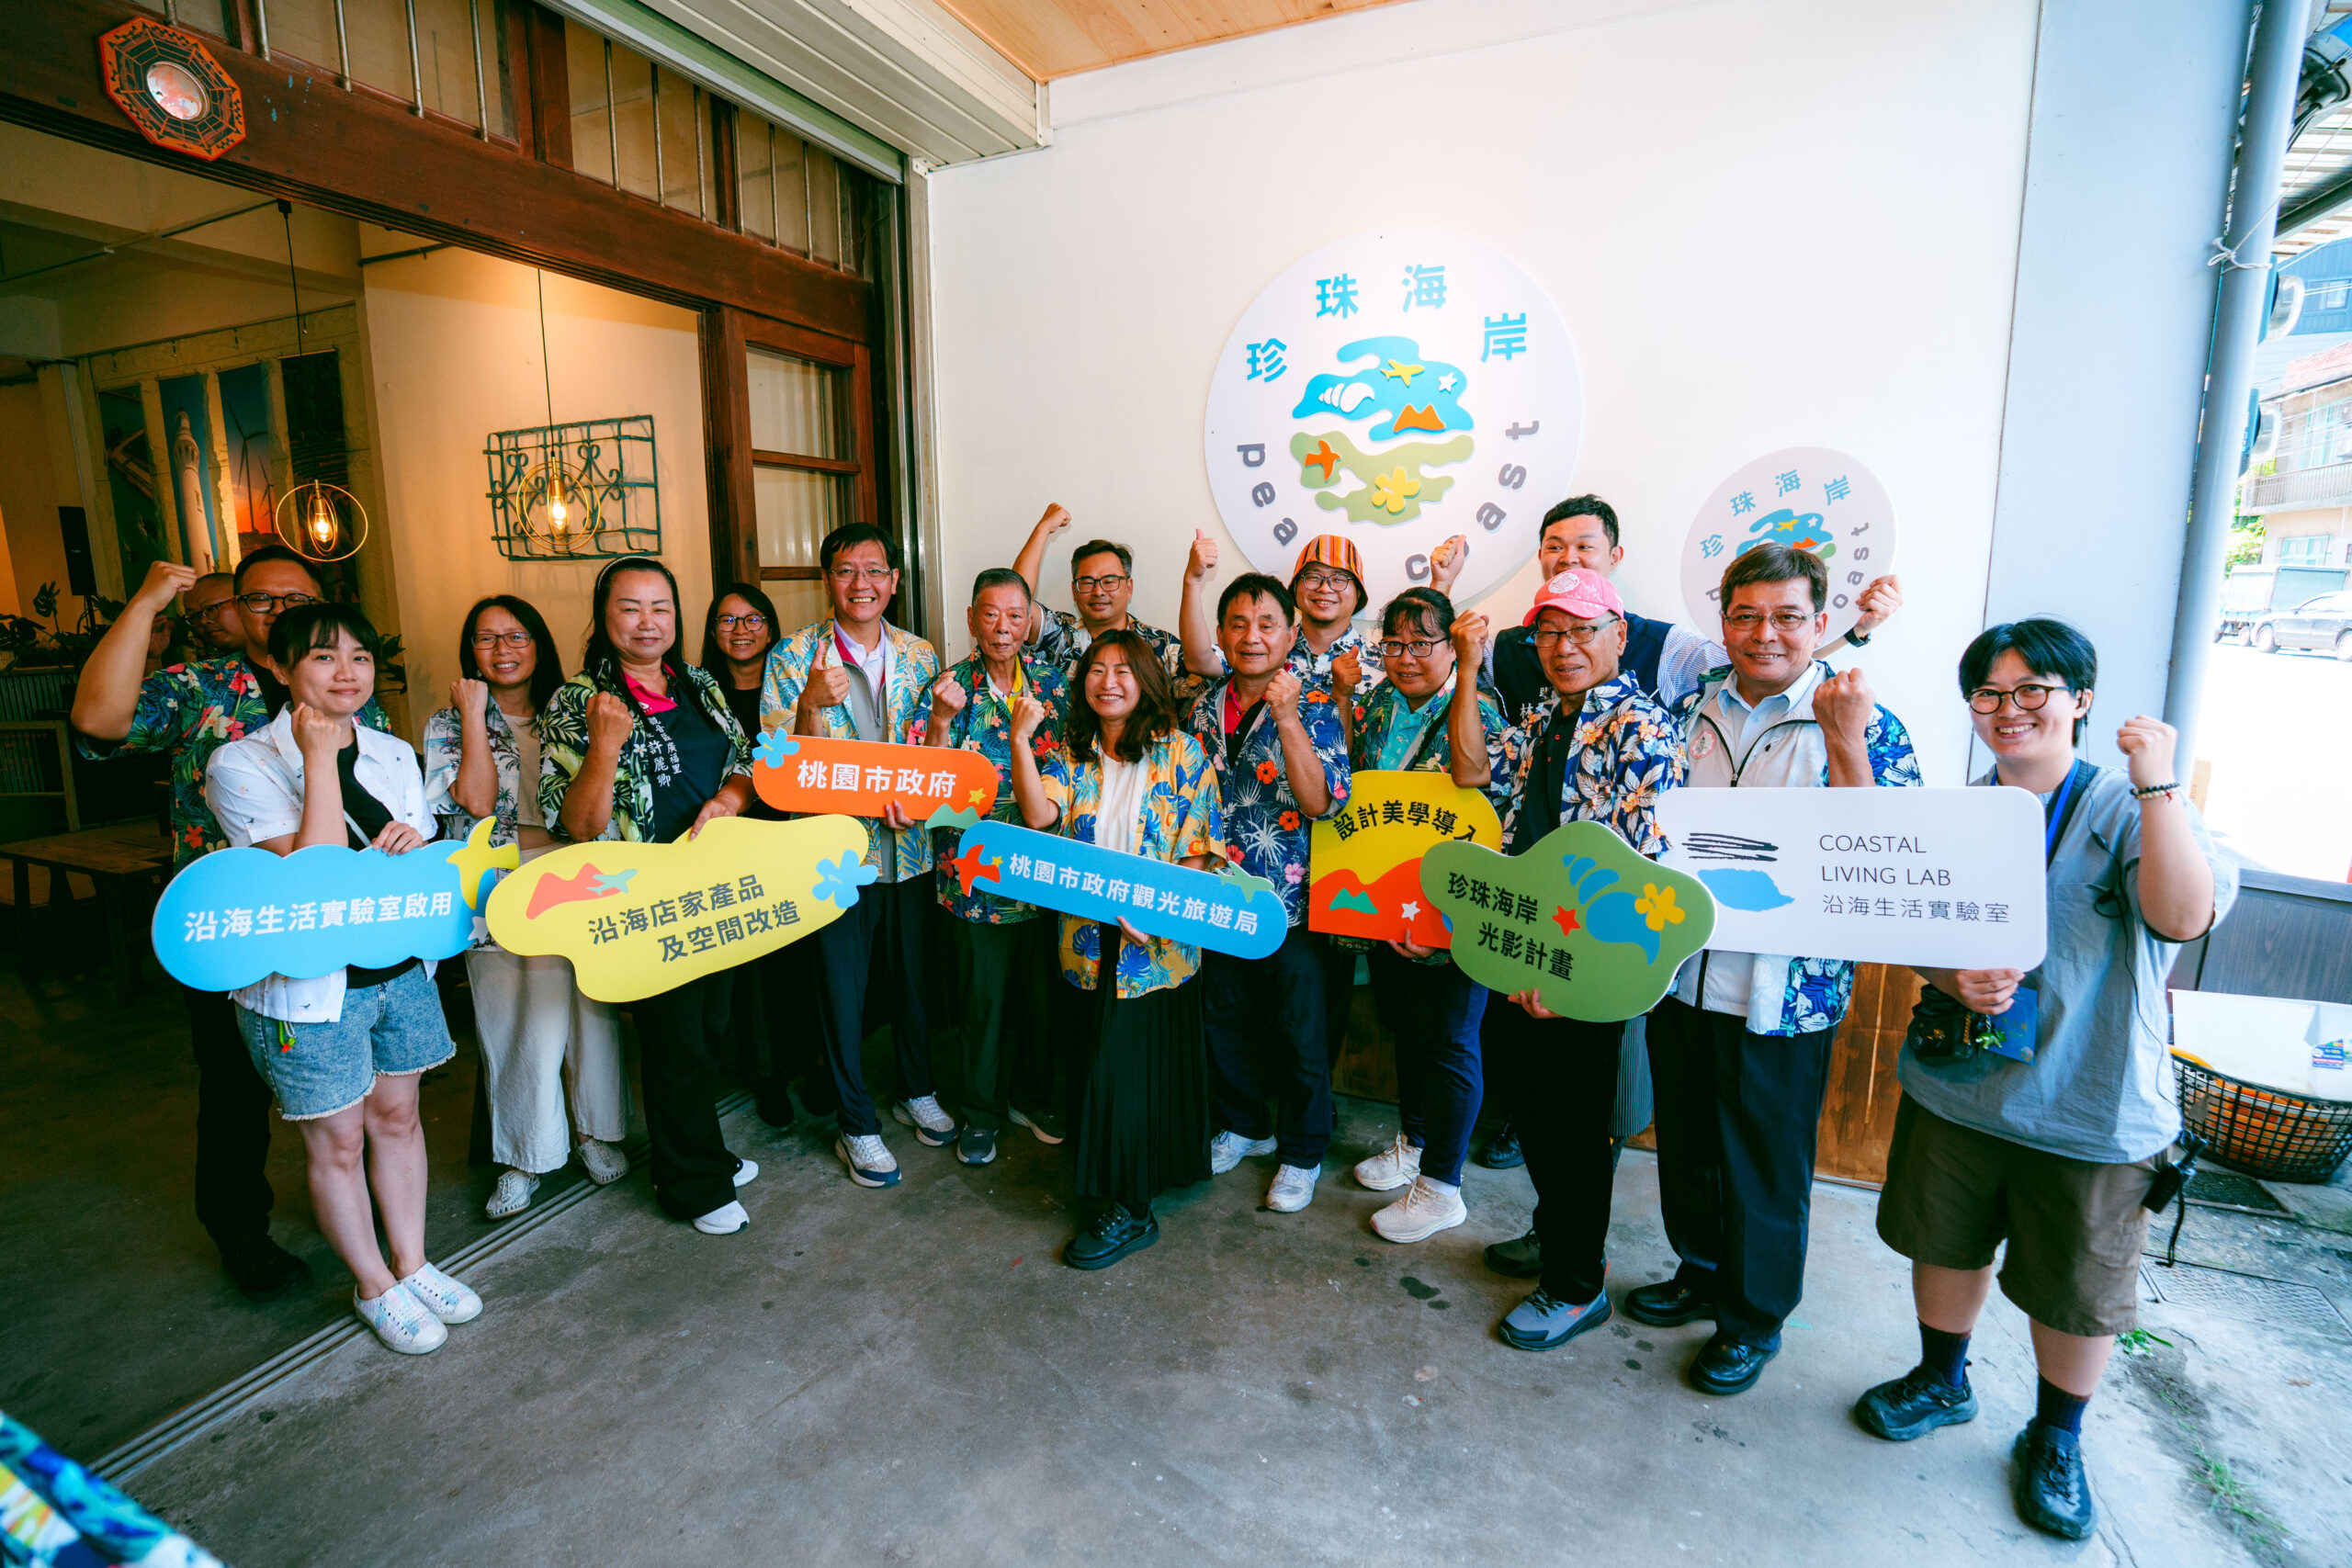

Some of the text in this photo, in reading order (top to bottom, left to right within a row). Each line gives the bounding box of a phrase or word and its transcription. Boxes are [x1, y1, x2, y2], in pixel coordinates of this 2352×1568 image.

[1246, 264, 1529, 383] 珍珠海岸
[1700, 468, 1851, 559] 珍珠海岸
[797, 759, 957, 800] 桃園市政府
[1333, 799, 1477, 842] 設計美學導入
[1819, 834, 1928, 854] COASTAL
[1009, 852, 1260, 935] 桃園市政府觀光旅遊局
[1447, 872, 1538, 925] 珍珠海岸
[1821, 865, 1951, 886] LIVING LAB
[184, 891, 452, 942] 沿海生活實驗室啟用
[588, 874, 765, 945] 沿海店家產品
[658, 900, 801, 964] 及空間改造
[1822, 894, 2010, 923] 沿海生活實驗室
[1477, 921, 1574, 981] 光影計畫
